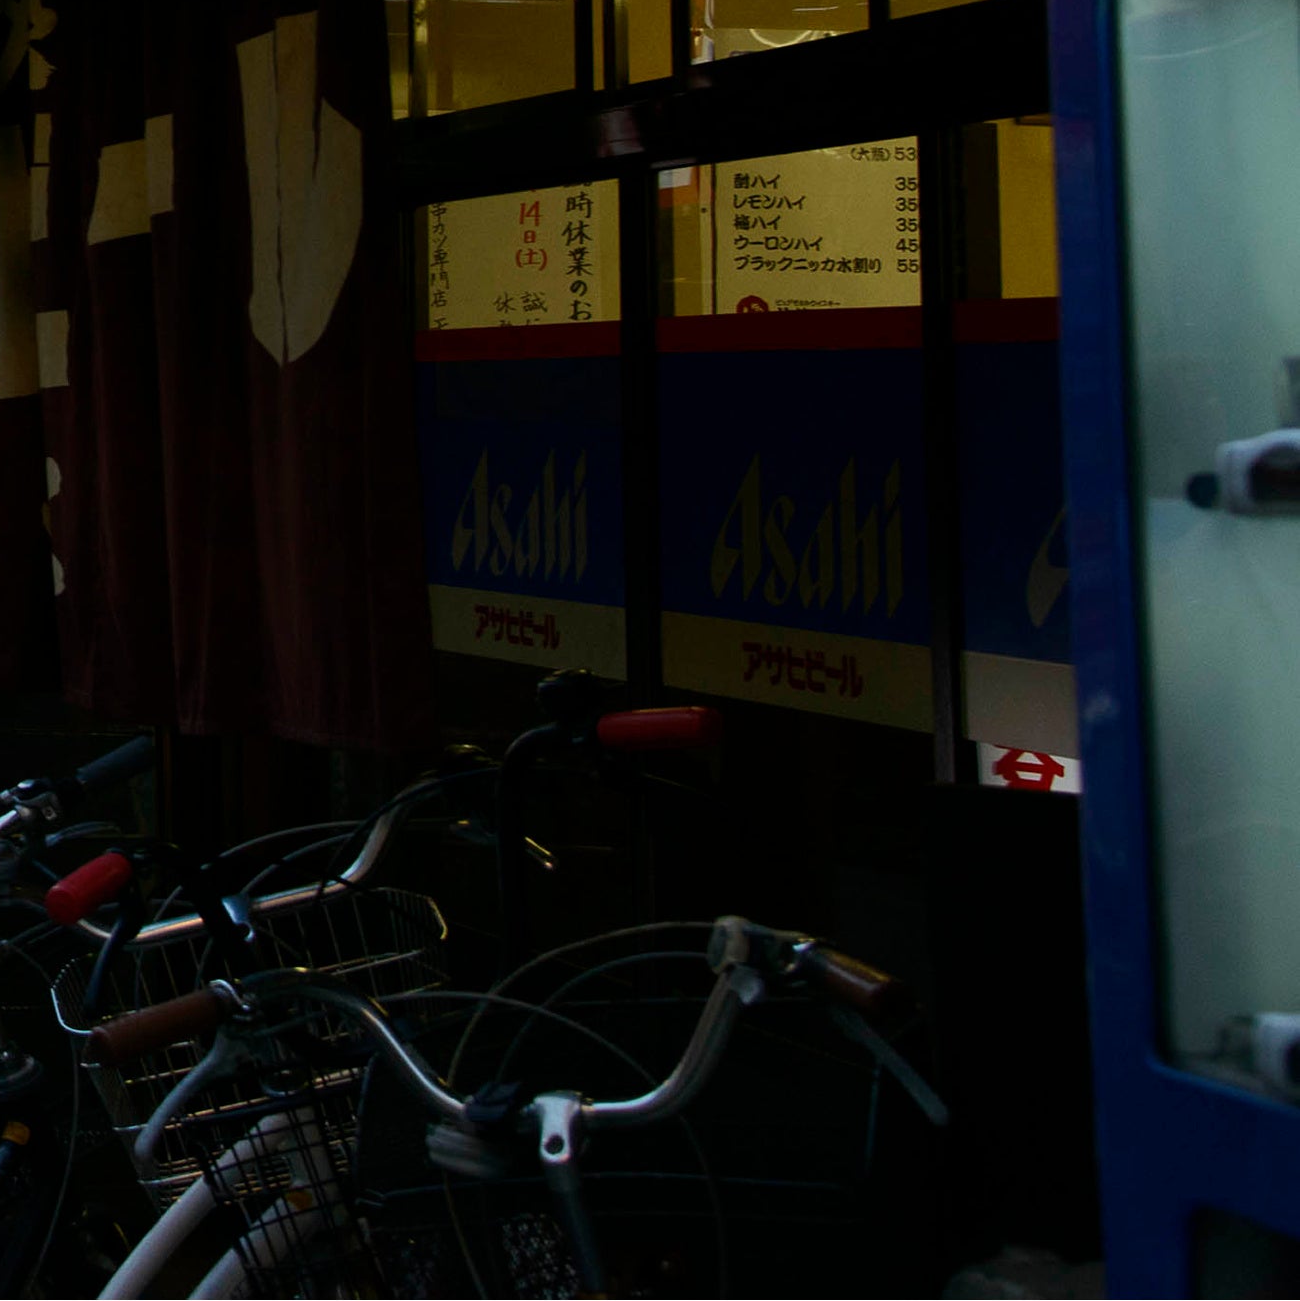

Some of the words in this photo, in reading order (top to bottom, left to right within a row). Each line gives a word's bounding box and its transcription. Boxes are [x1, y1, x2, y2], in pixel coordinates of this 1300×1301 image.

[733, 194, 806, 211] レモンハイ
[561, 181, 595, 321] 時休業のお
[733, 235, 824, 251] ウーロンハイ
[733, 256, 882, 274] ブラックニッカ水割り
[450, 444, 589, 584] Asahi
[708, 450, 905, 619] Asahi
[474, 604, 561, 651] アサヒビール
[742, 641, 864, 699] アサヒビール
